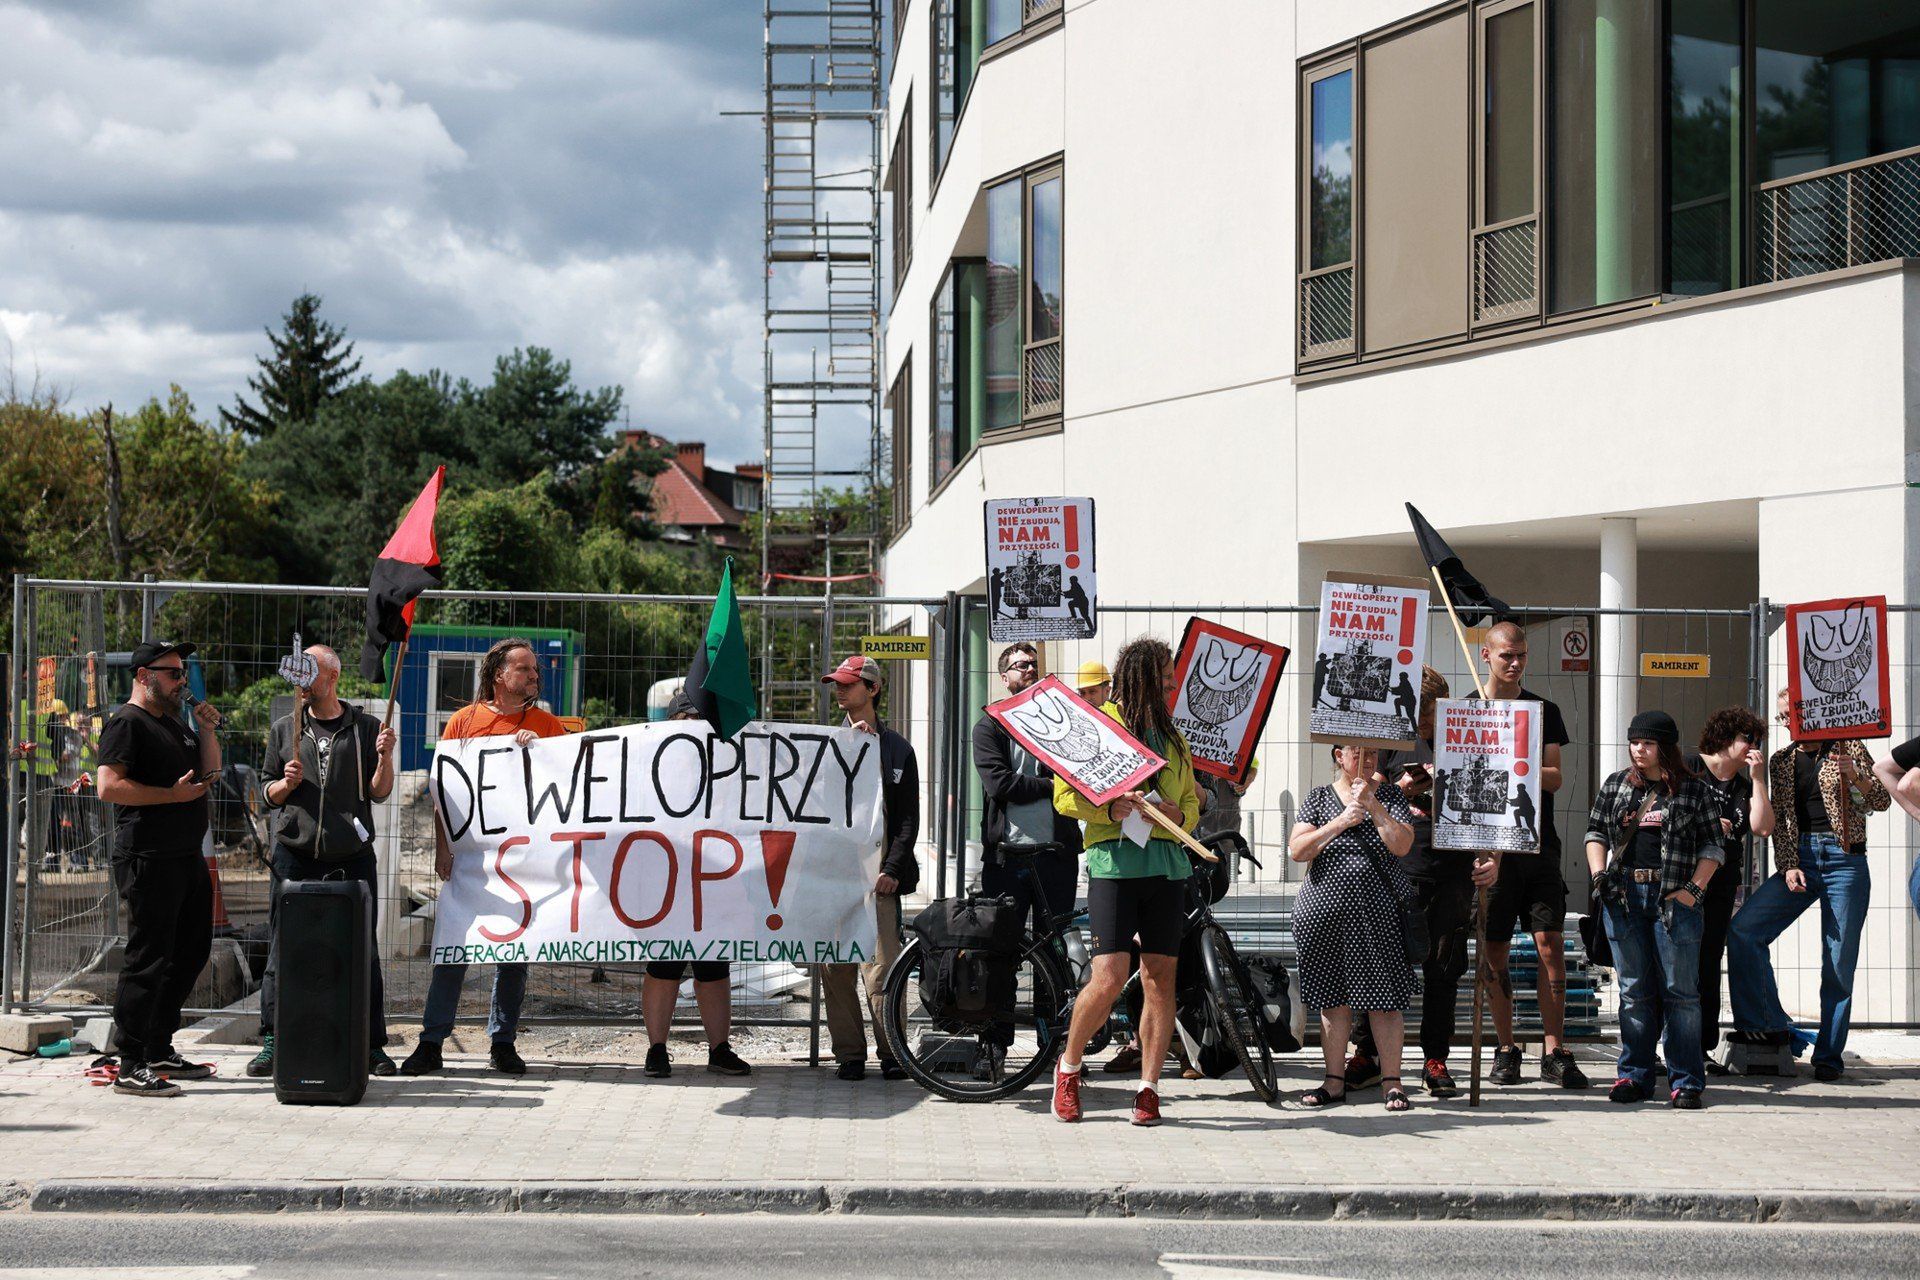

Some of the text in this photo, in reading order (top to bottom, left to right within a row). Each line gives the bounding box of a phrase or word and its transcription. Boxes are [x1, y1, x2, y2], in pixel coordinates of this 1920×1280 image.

[997, 506, 1060, 515] DEWELOPERZY
[997, 517, 1019, 527] NIE
[998, 527, 1051, 543] NAM
[1332, 591, 1399, 603] DEWELOPERZY
[1331, 600, 1398, 616] NIE ZBUDUJĄ
[1329, 612, 1385, 632] NAM
[865, 642, 926, 652] RAMIRENT
[1651, 661, 1700, 670] RAMIRENT
[1446, 708, 1511, 717] DEWELOPERZY
[1446, 717, 1511, 729] NIE ZBUDUJĄ
[1799, 720, 1821, 734] NAM
[1446, 728, 1500, 745] NAM
[436, 732, 871, 843] DEWELOPERZY
[477, 829, 797, 942] STOP!
[432, 942, 526, 964] FEDERACJA
[814, 941, 865, 962] FALA
